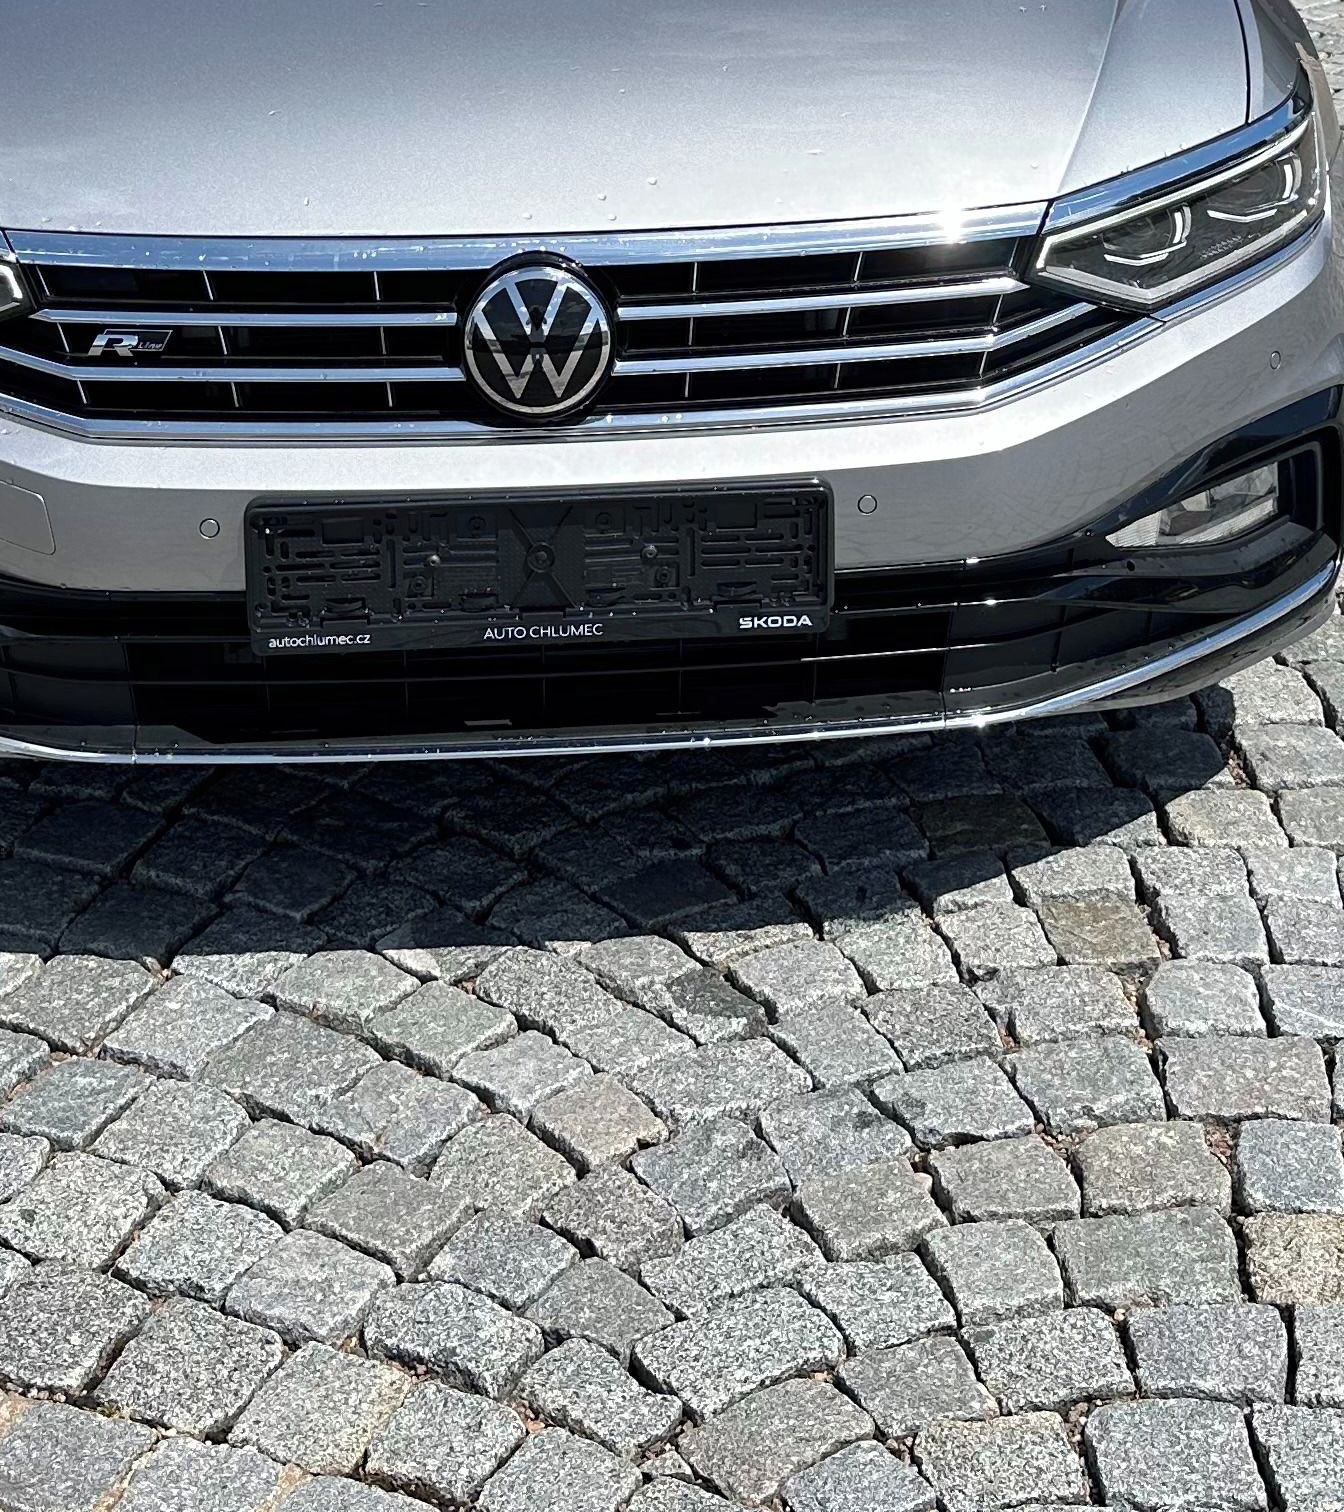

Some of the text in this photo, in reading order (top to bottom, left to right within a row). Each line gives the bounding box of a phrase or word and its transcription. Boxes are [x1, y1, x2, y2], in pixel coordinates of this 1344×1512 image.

[483, 623, 604, 640] AUTO CHLUMEC
[268, 634, 371, 648] autochlumec.cz
